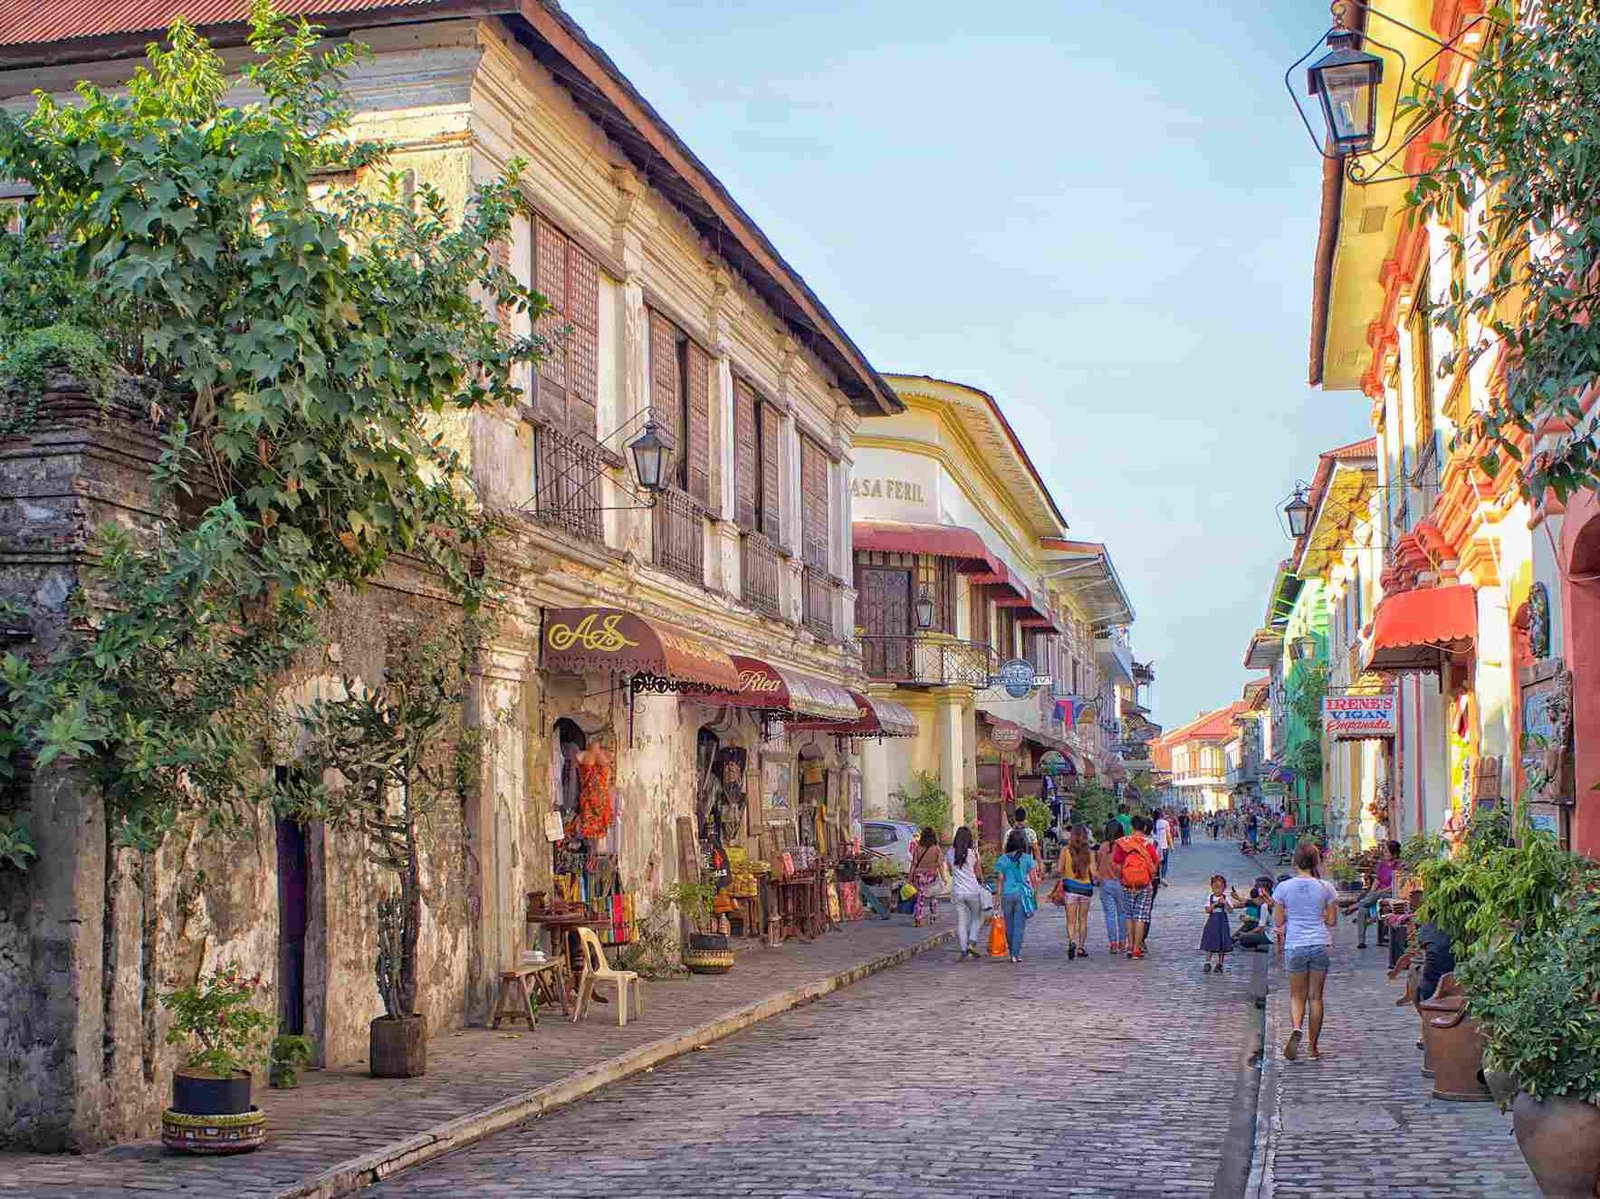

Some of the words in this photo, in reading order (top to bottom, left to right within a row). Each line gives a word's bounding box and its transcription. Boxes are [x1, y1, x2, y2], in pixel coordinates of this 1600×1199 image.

[851, 478, 883, 498] ASA
[1325, 696, 1392, 710] IRENE'S
[1331, 710, 1388, 719] VIGAN
